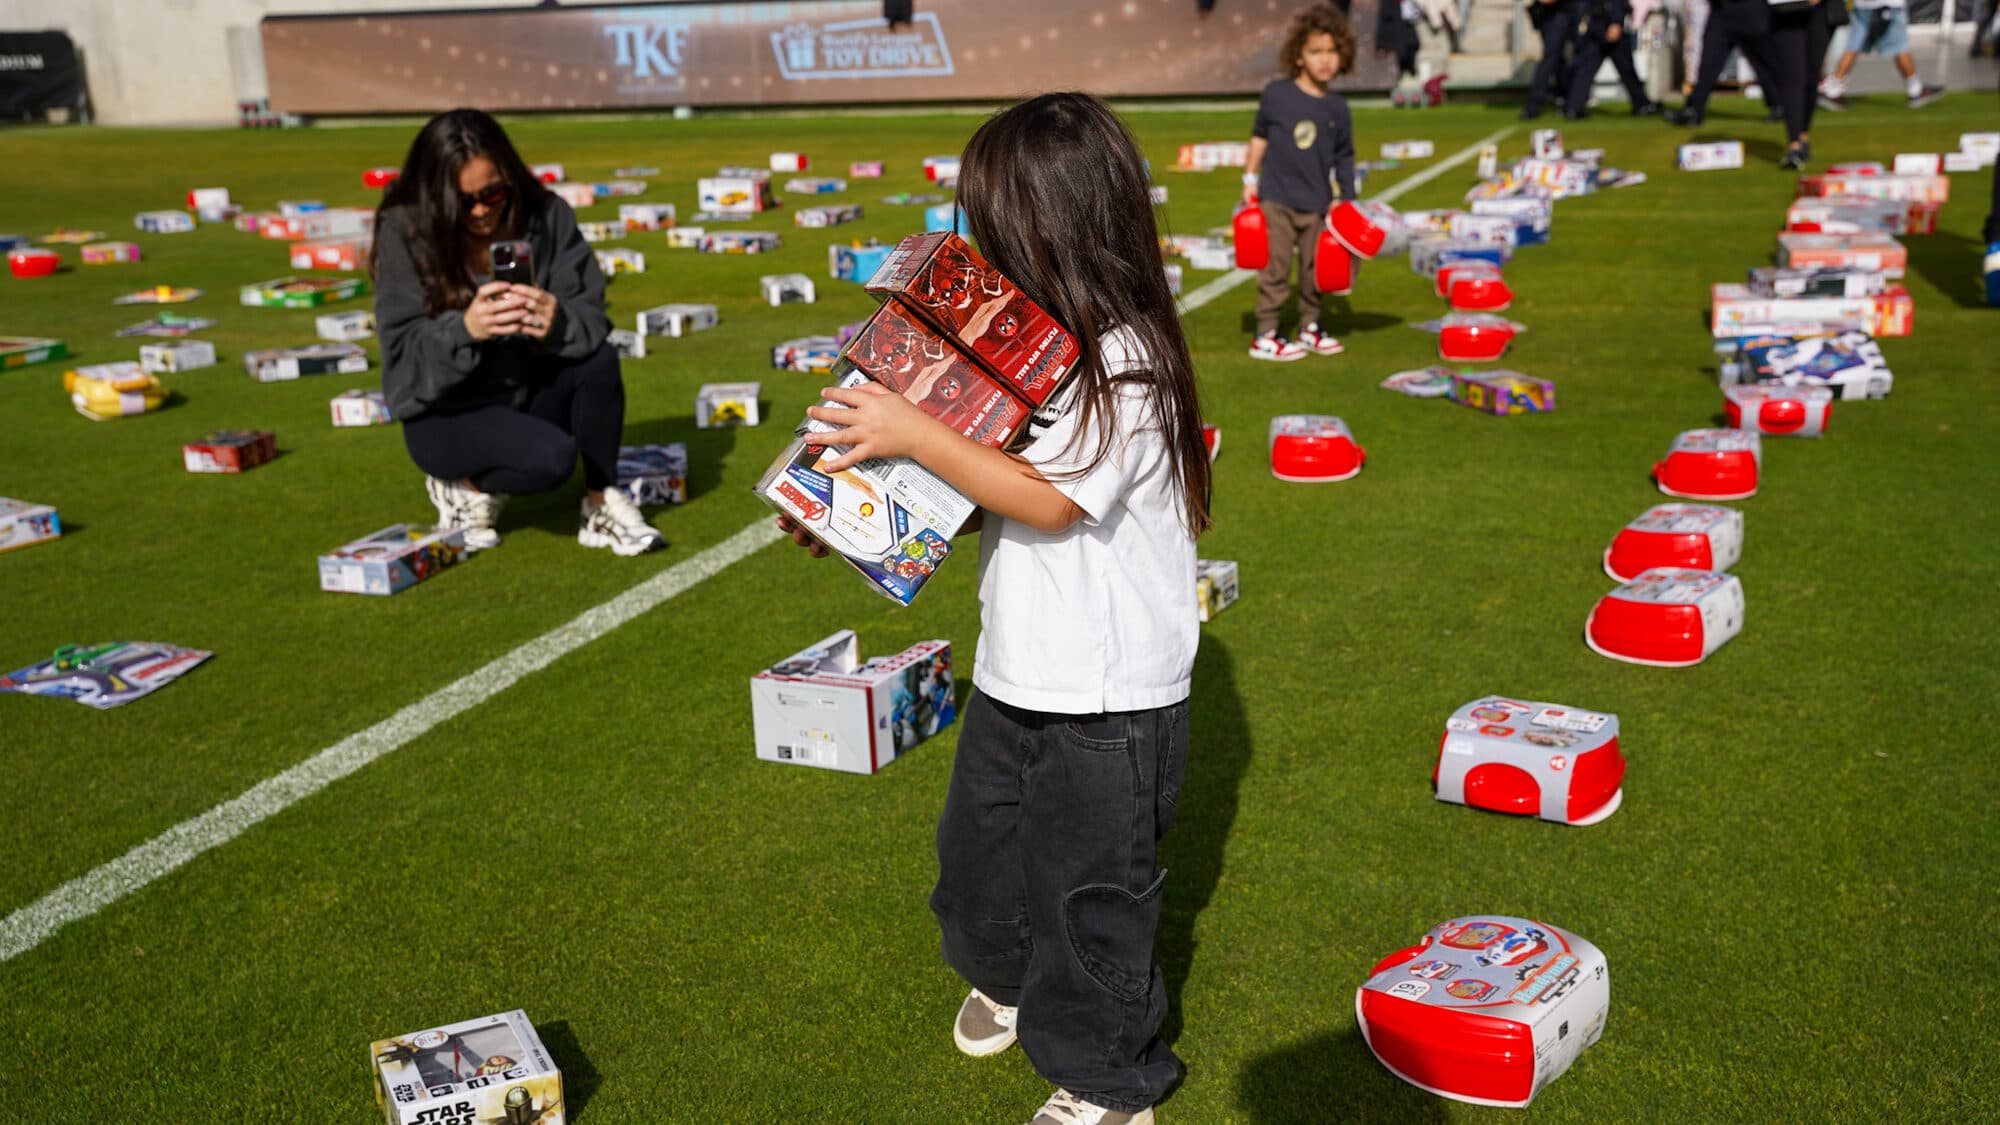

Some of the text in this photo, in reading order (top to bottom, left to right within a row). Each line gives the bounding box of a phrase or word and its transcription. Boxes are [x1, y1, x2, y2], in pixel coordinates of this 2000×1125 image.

[603, 24, 688, 77] TKF
[823, 43, 938, 68] TOY DRIVE
[1038, 327, 1059, 351] FLYING
[1023, 333, 1073, 390] DEADPOOL
[1028, 350, 1041, 365] UFO
[1014, 363, 1030, 380] BALL
[982, 390, 1003, 413] FLYING
[972, 412, 985, 426] UFO
[774, 480, 828, 521] AVENGERS
[1392, 983, 1415, 994] 19
[408, 1101, 476, 1125] STAR
